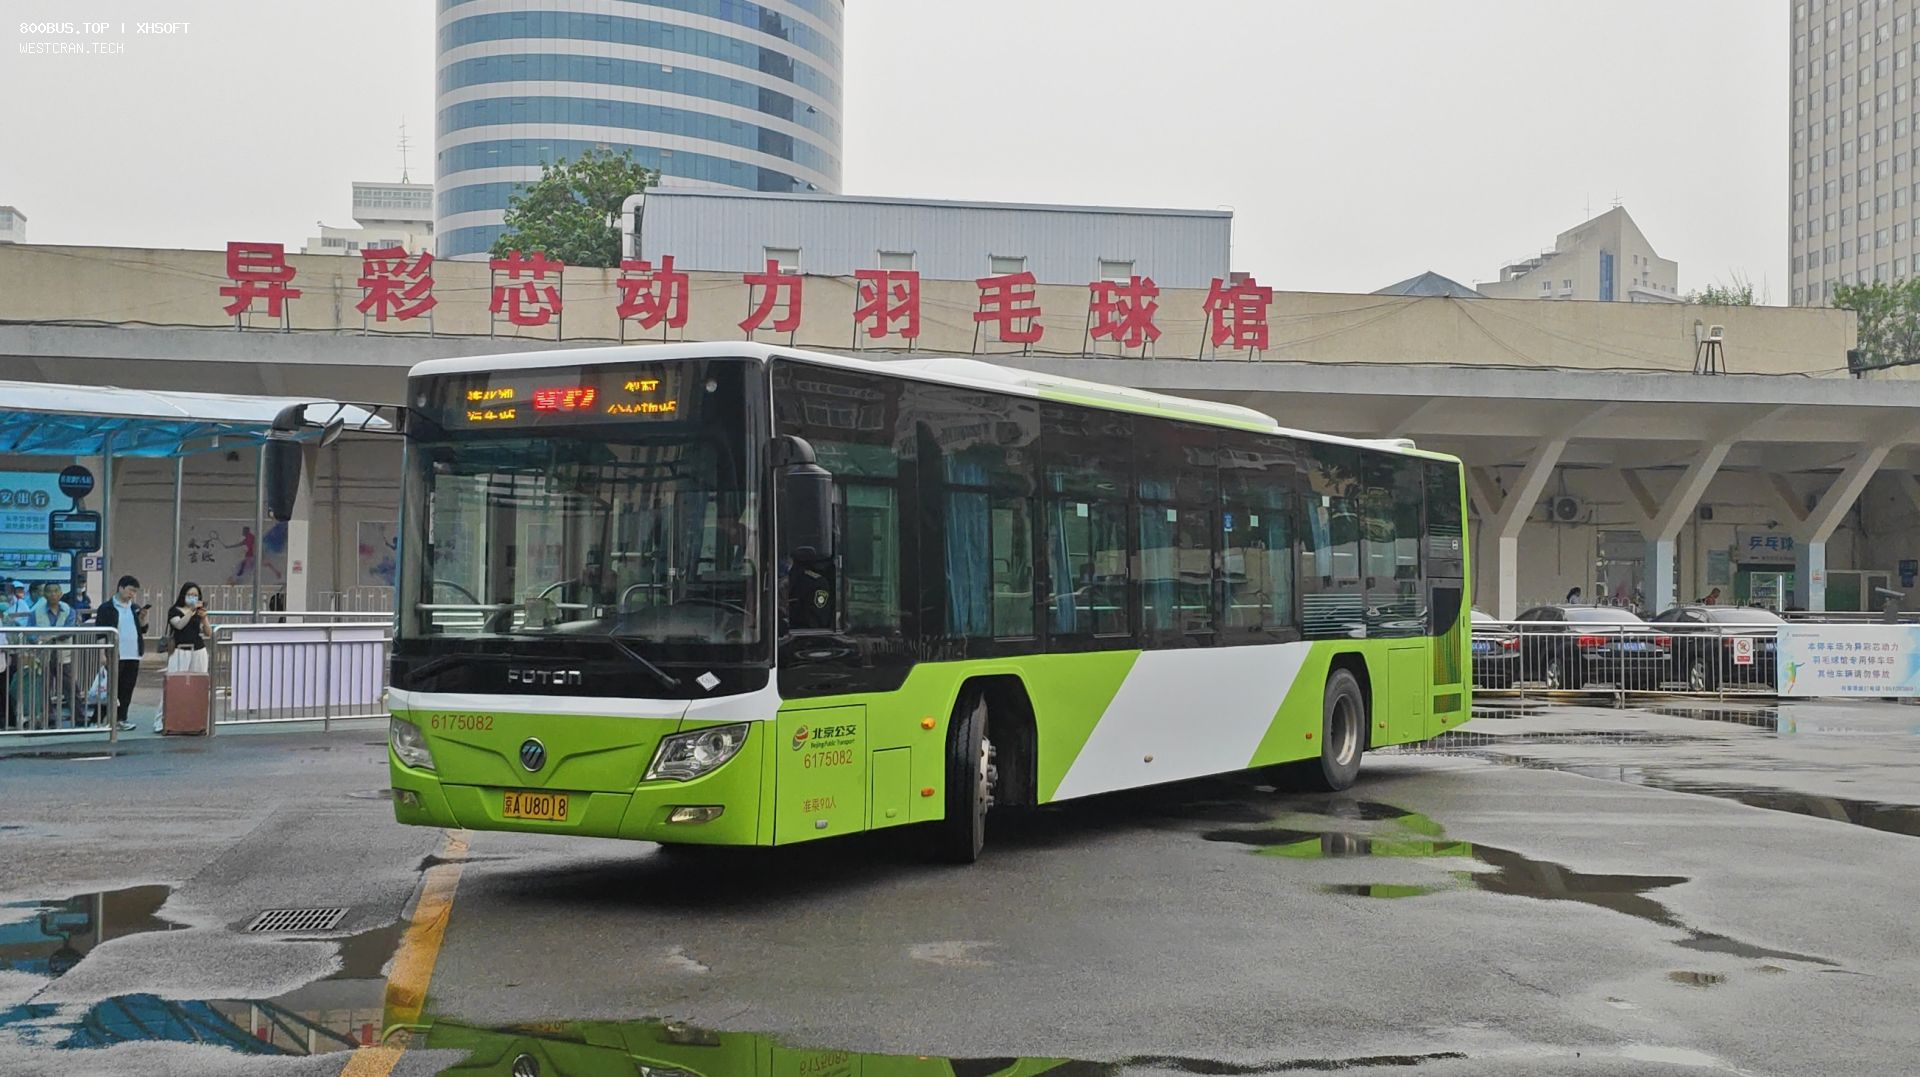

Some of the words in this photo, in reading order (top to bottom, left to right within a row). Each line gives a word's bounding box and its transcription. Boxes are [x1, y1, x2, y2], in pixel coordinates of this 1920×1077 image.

[219, 241, 1274, 350] 异彩芯动力羽毛球馆
[1749, 536, 1794, 551] 乒乓球
[1812, 655, 1895, 665] 羽毛球馆专用停车场
[508, 669, 582, 685] FOTON
[1817, 669, 1890, 679] 其他车辆请勿停放
[431, 714, 494, 731] 6175082
[812, 724, 857, 740] 北京公交
[804, 749, 853, 769] 6175082
[803, 796, 837, 813] 准乘90人
